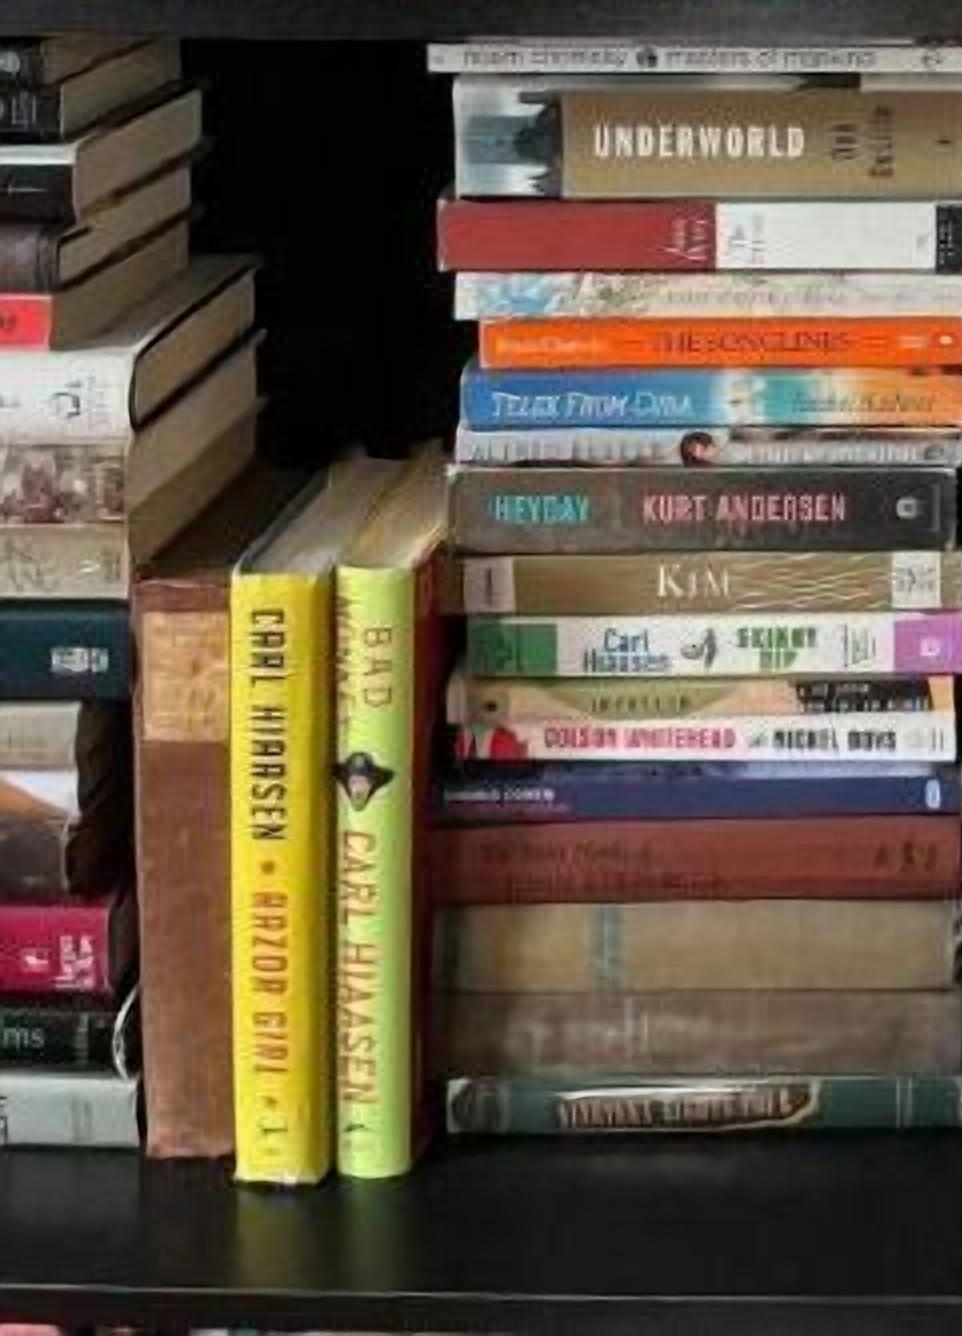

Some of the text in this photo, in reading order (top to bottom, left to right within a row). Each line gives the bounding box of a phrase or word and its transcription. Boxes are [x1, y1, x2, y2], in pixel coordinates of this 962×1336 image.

[593, 122, 806, 159] UNDERWORLD
[492, 494, 591, 525] HEYDAY
[642, 490, 848, 522] KURT ANDERSEN
[656, 563, 730, 599] KIM
[250, 607, 290, 1078] CARL HIAASEN RAZOR GIRL
[341, 830, 379, 1107] CARL HIAASEN
